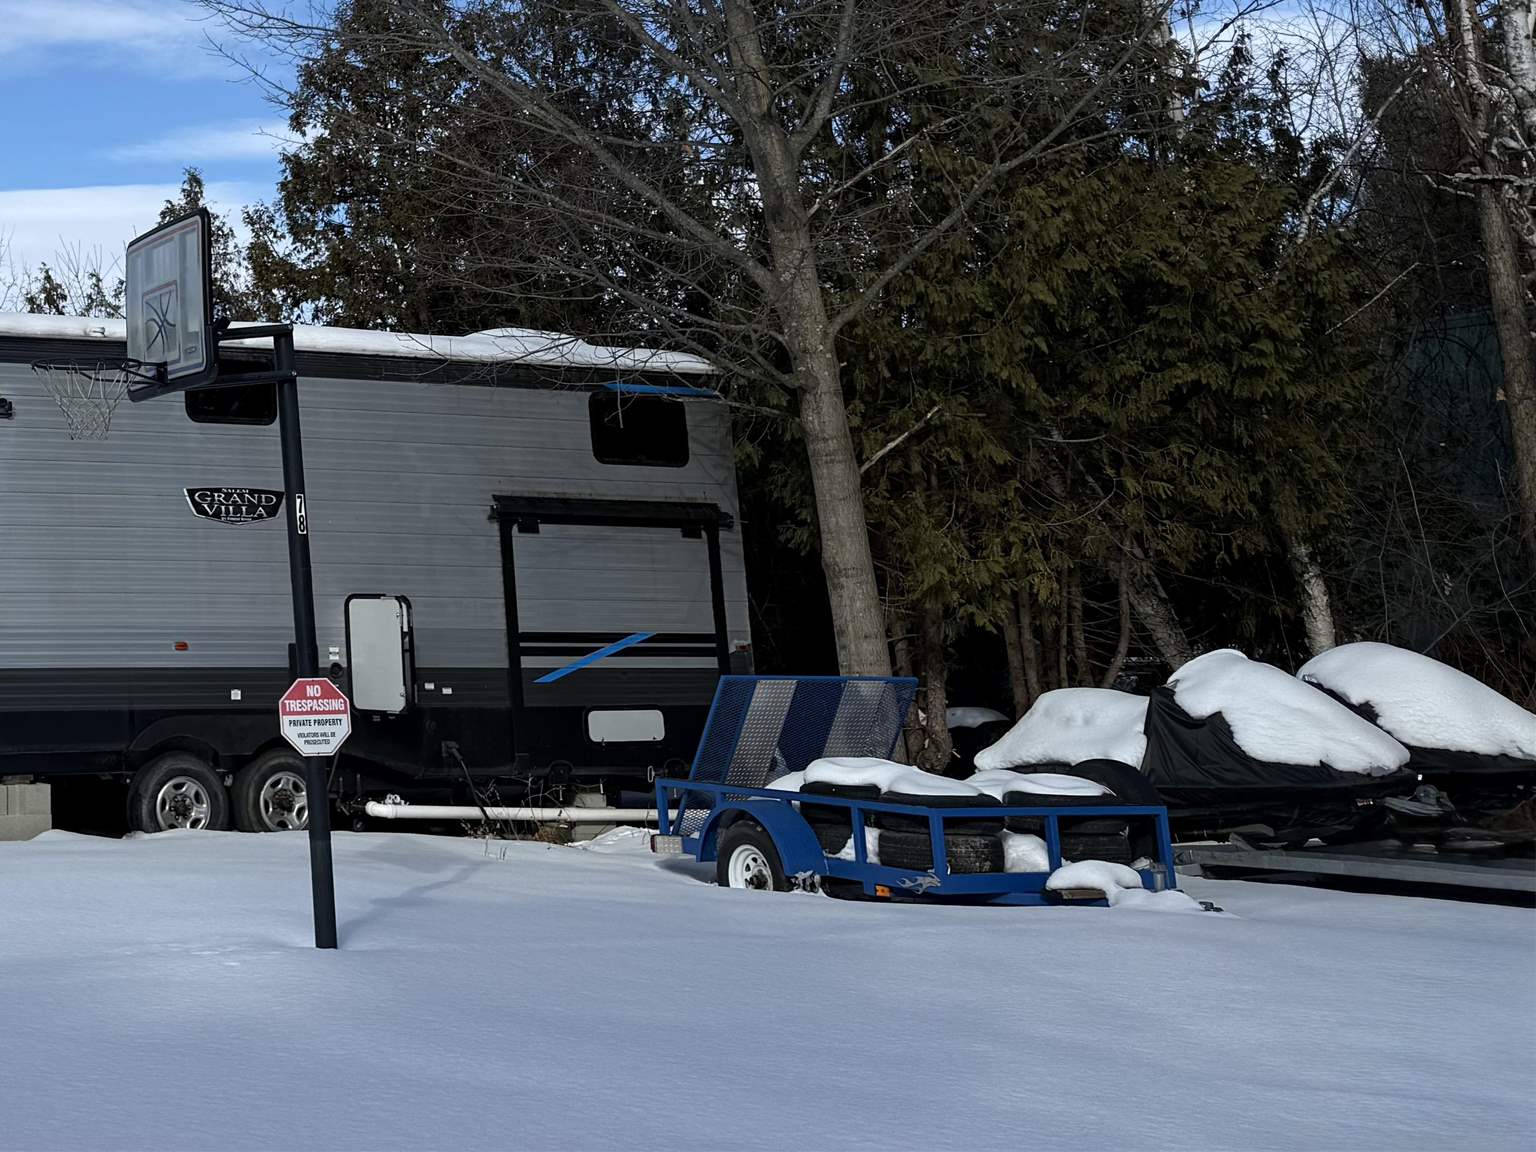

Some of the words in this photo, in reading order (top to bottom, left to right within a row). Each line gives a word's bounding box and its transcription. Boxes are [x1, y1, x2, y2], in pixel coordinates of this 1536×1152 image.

[194, 491, 277, 505] GRAND
[201, 504, 268, 518] VILLA
[296, 494, 306, 533] 78
[305, 685, 322, 697] NO
[284, 699, 345, 712] TRESPASSING
[288, 719, 313, 727] PRIVATE
[313, 718, 343, 727] PROPERTY
